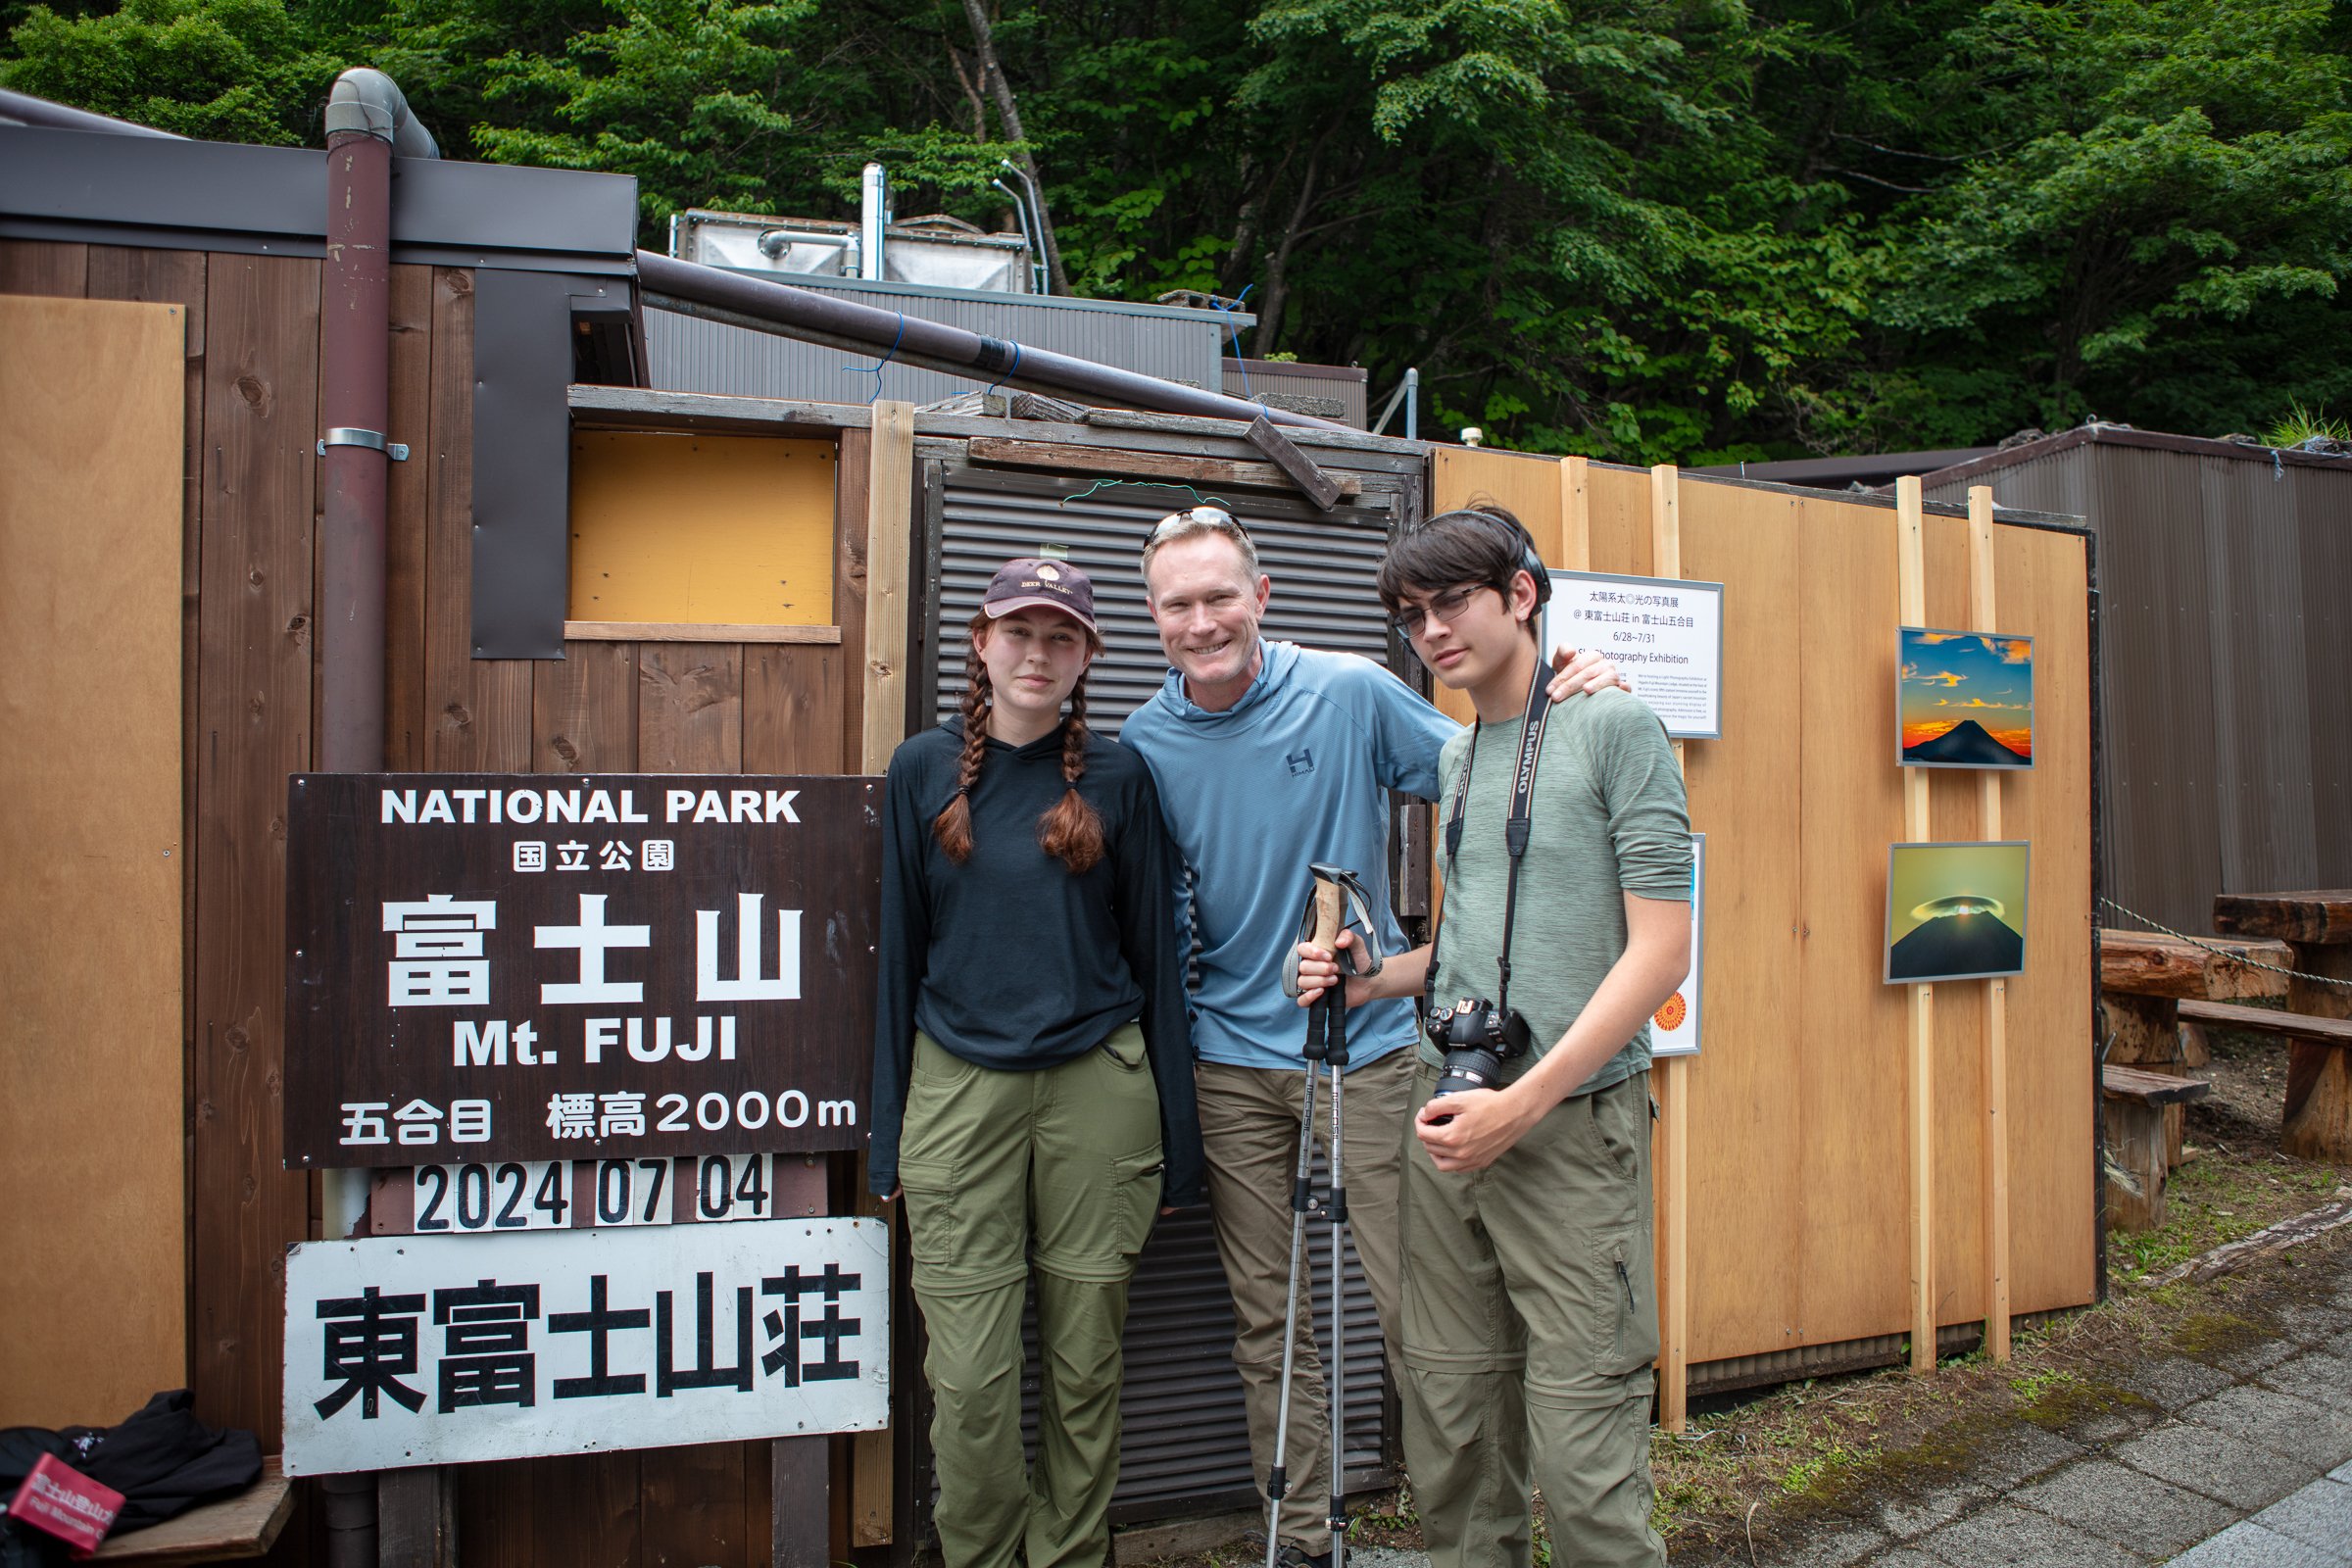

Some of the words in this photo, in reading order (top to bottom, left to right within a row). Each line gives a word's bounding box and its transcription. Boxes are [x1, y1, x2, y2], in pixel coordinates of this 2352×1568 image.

[1573, 609, 1582, 619] @
[1584, 610, 1630, 623] 東富士山荘
[1632, 614, 1640, 623] in
[1642, 613, 1693, 627] 富士山五合目
[1649, 652, 1689, 663] Exhibition
[1518, 720, 1540, 794] OLYMPUS
[380, 789, 649, 824] NATIONAL
[665, 789, 802, 823] PARK
[513, 839, 675, 873] 国立公園
[381, 892, 804, 1007] 富士山
[453, 1019, 558, 1067] Mt.
[584, 1015, 737, 1064] FUJI
[339, 1098, 492, 1146] 五合目
[546, 1089, 857, 1140] 標高2000m
[416, 1160, 569, 1232] 2024
[598, 1158, 668, 1224] 07
[699, 1153, 768, 1219] 04
[314, 1262, 861, 1420] 東富士山荘
[50, 1506, 95, 1535] Mountain
